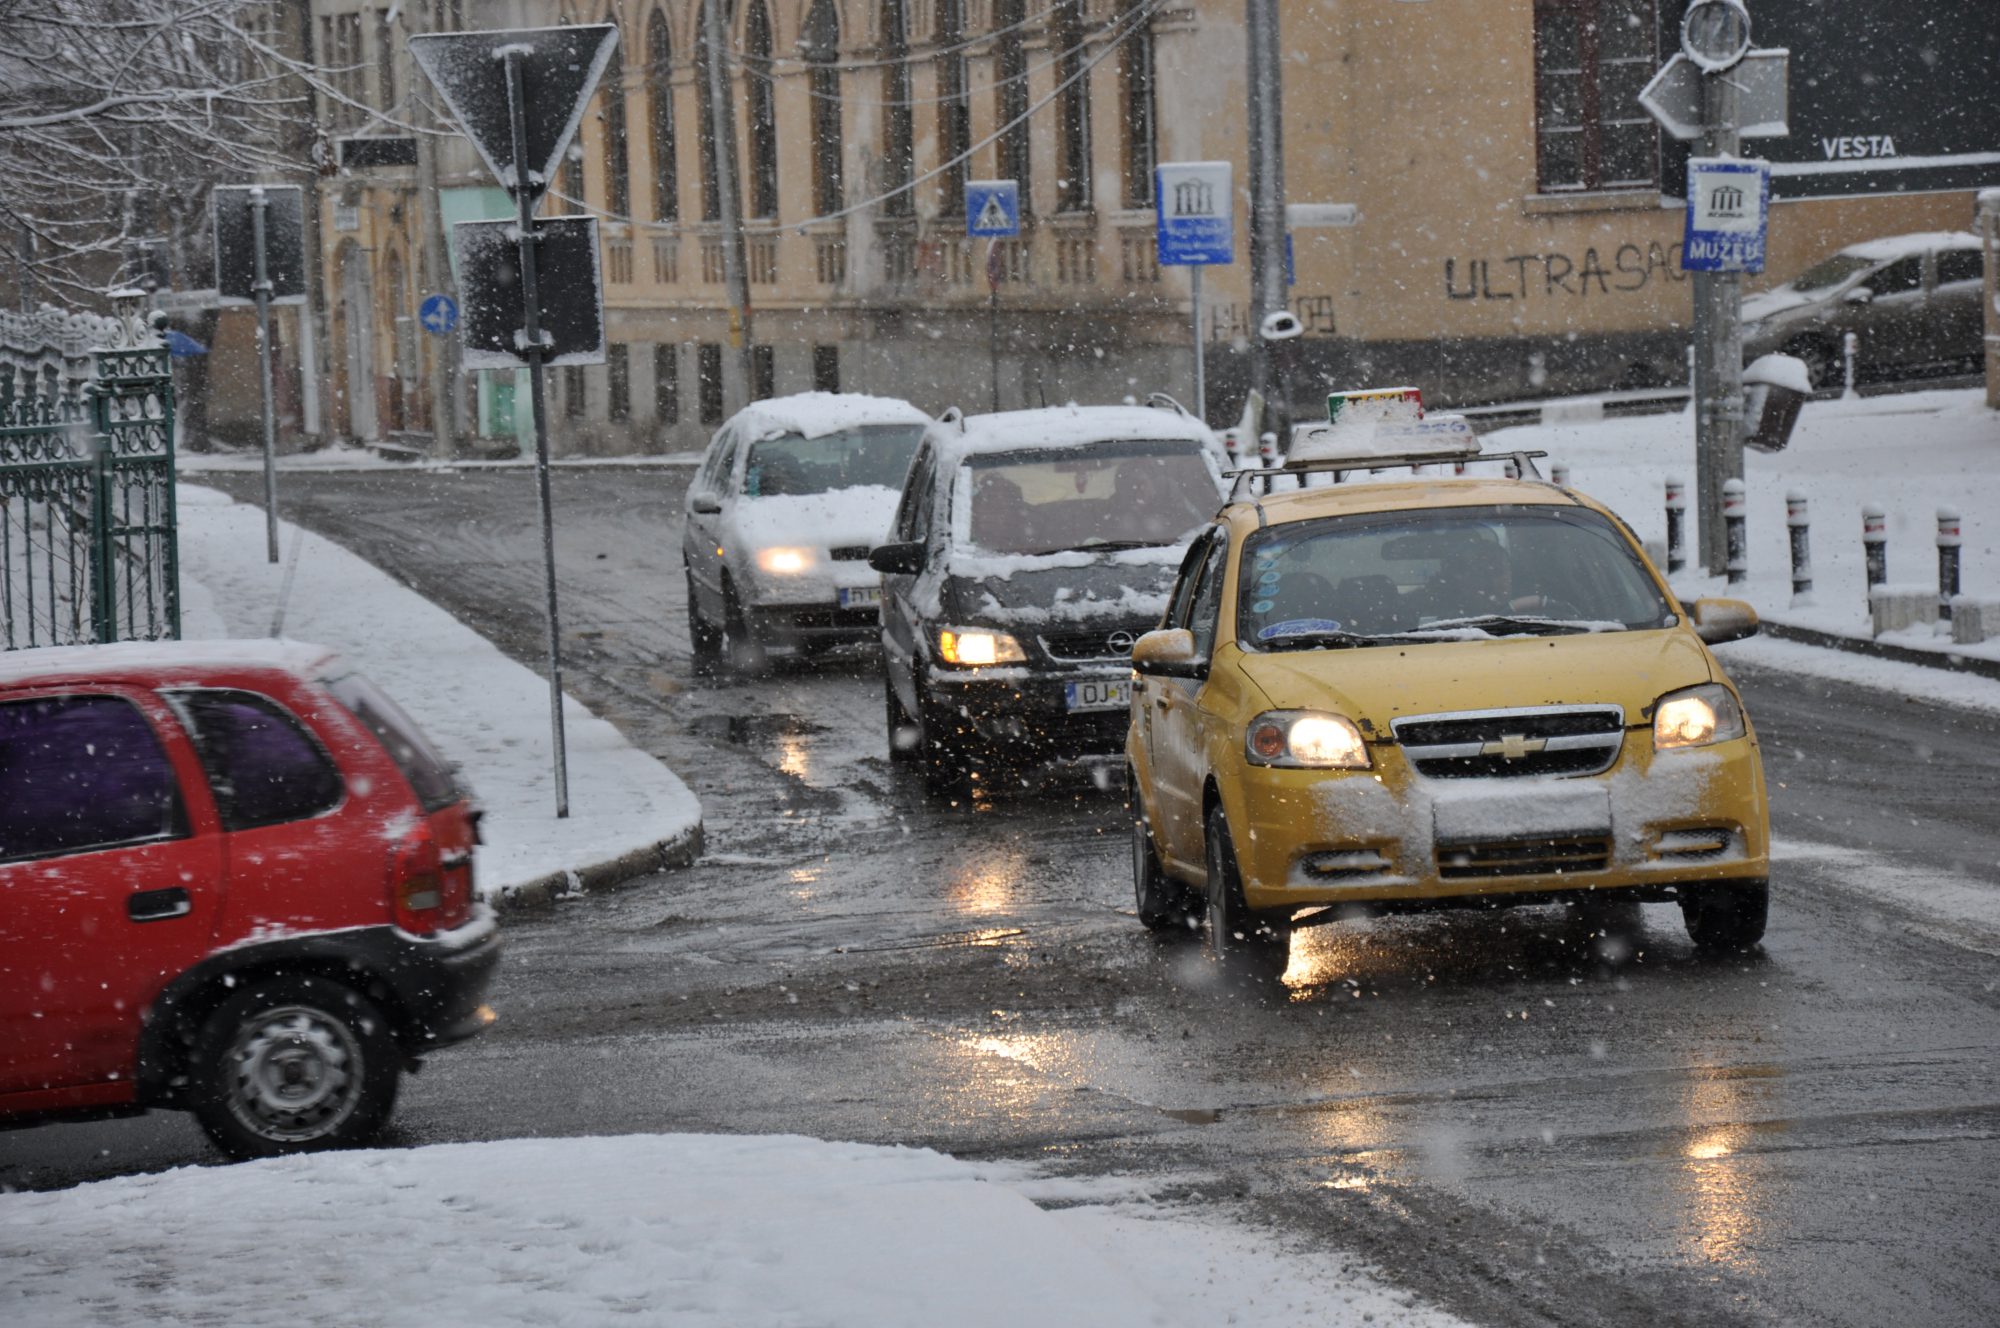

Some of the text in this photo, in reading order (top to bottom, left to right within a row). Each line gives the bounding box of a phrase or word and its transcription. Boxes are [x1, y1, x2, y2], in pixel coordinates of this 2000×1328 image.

[1822, 135, 1896, 160] VESTA
[1689, 239, 1758, 262] MUZEU
[1084, 684, 1108, 704] DJ
